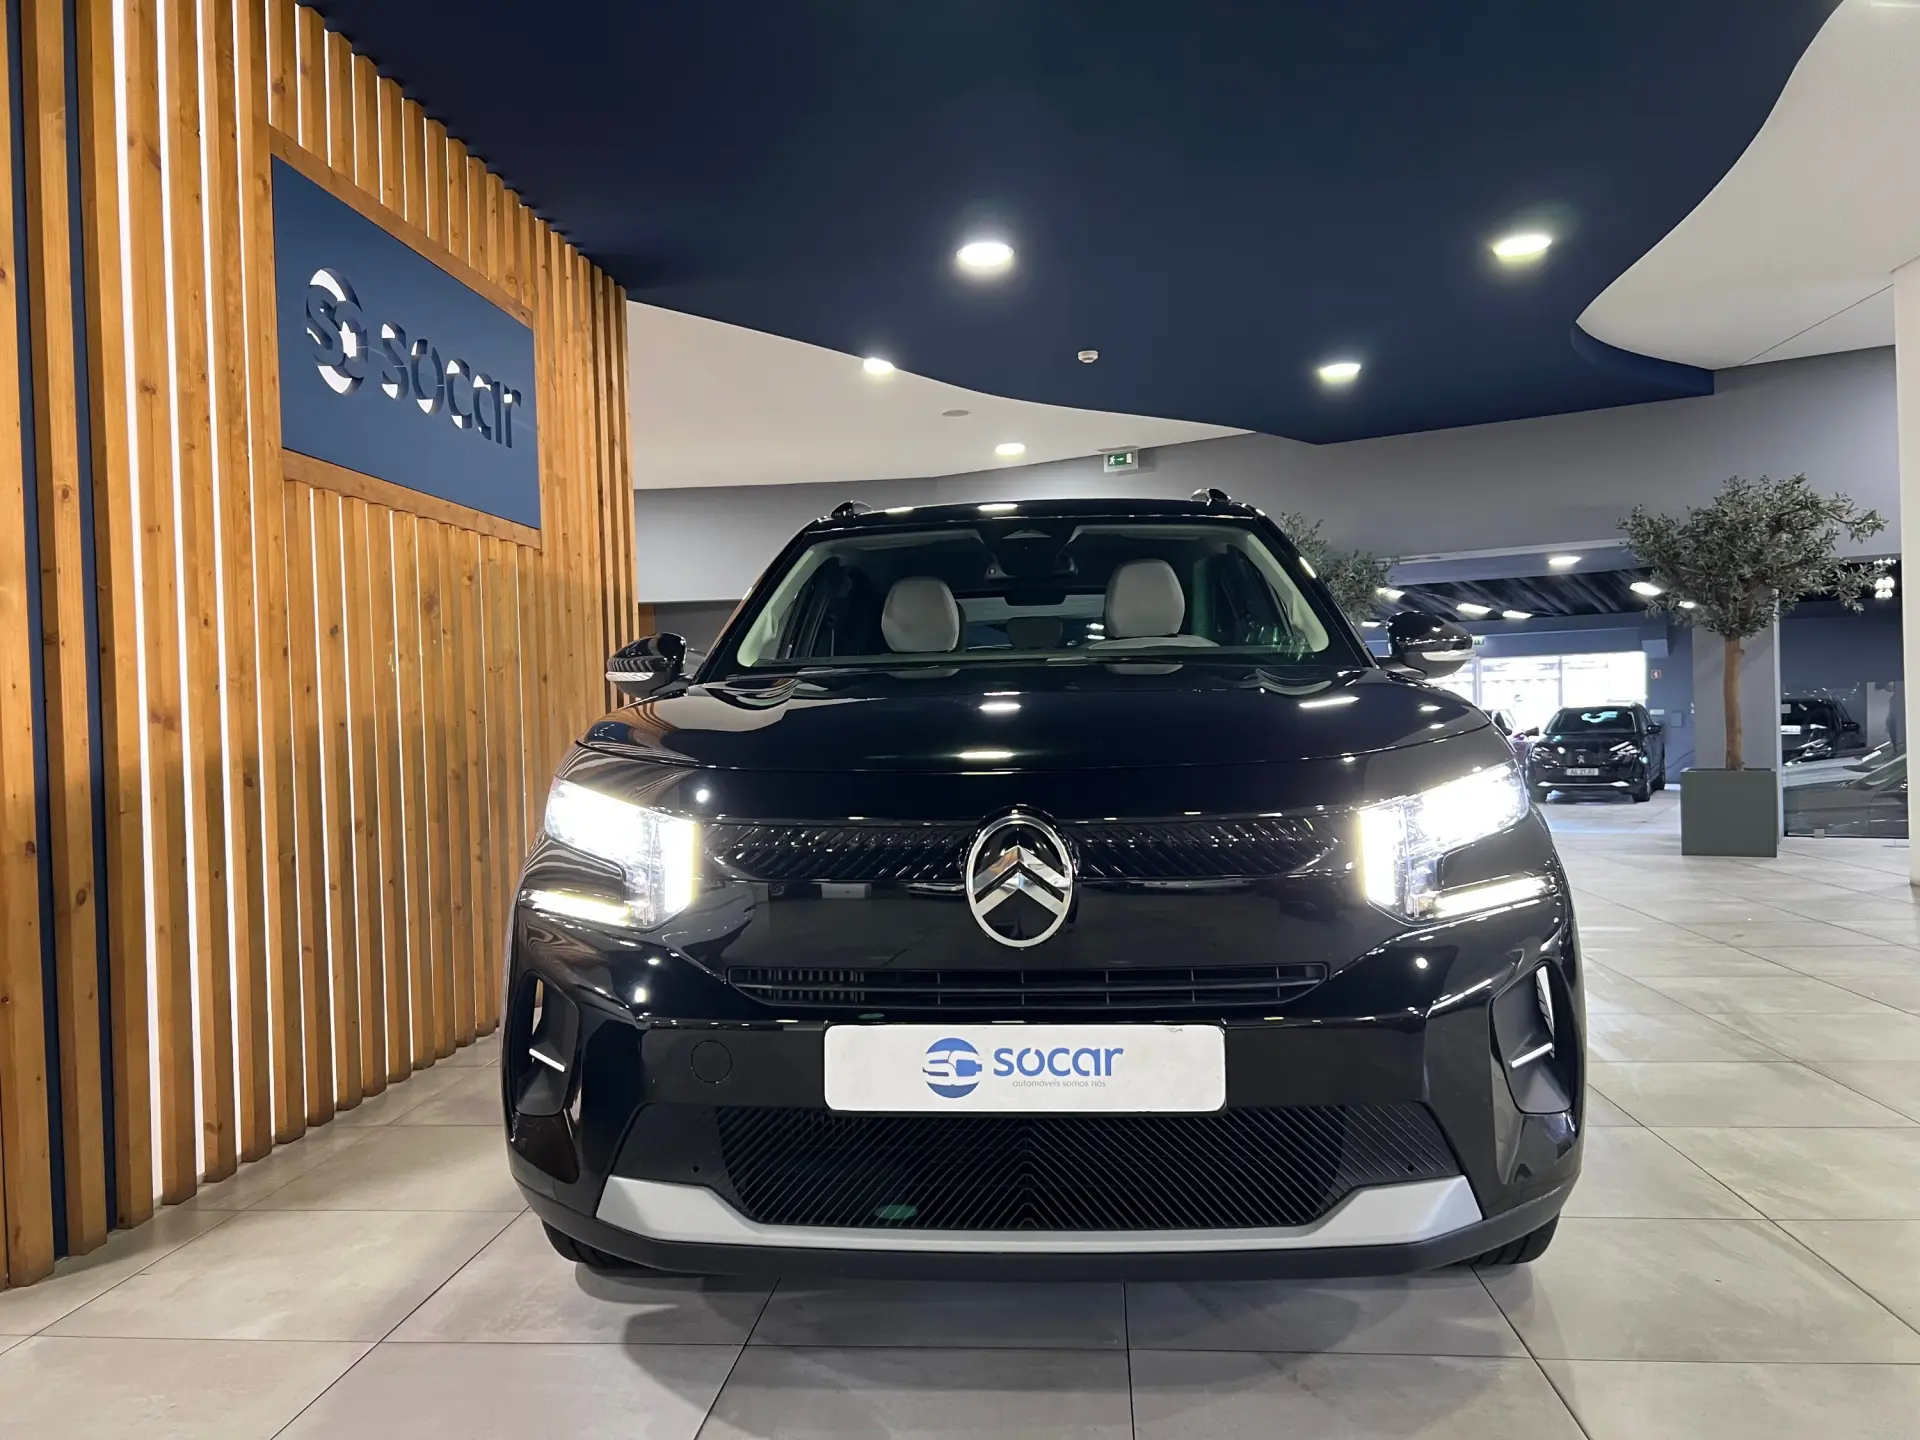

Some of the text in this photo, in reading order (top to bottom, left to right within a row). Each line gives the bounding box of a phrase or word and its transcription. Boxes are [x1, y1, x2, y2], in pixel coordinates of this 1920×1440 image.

[381, 321, 522, 449] socar
[994, 1048, 1124, 1076] socar
[1012, 1079, 1061, 1087] automóveis
[1091, 1079, 1106, 1087] nós
